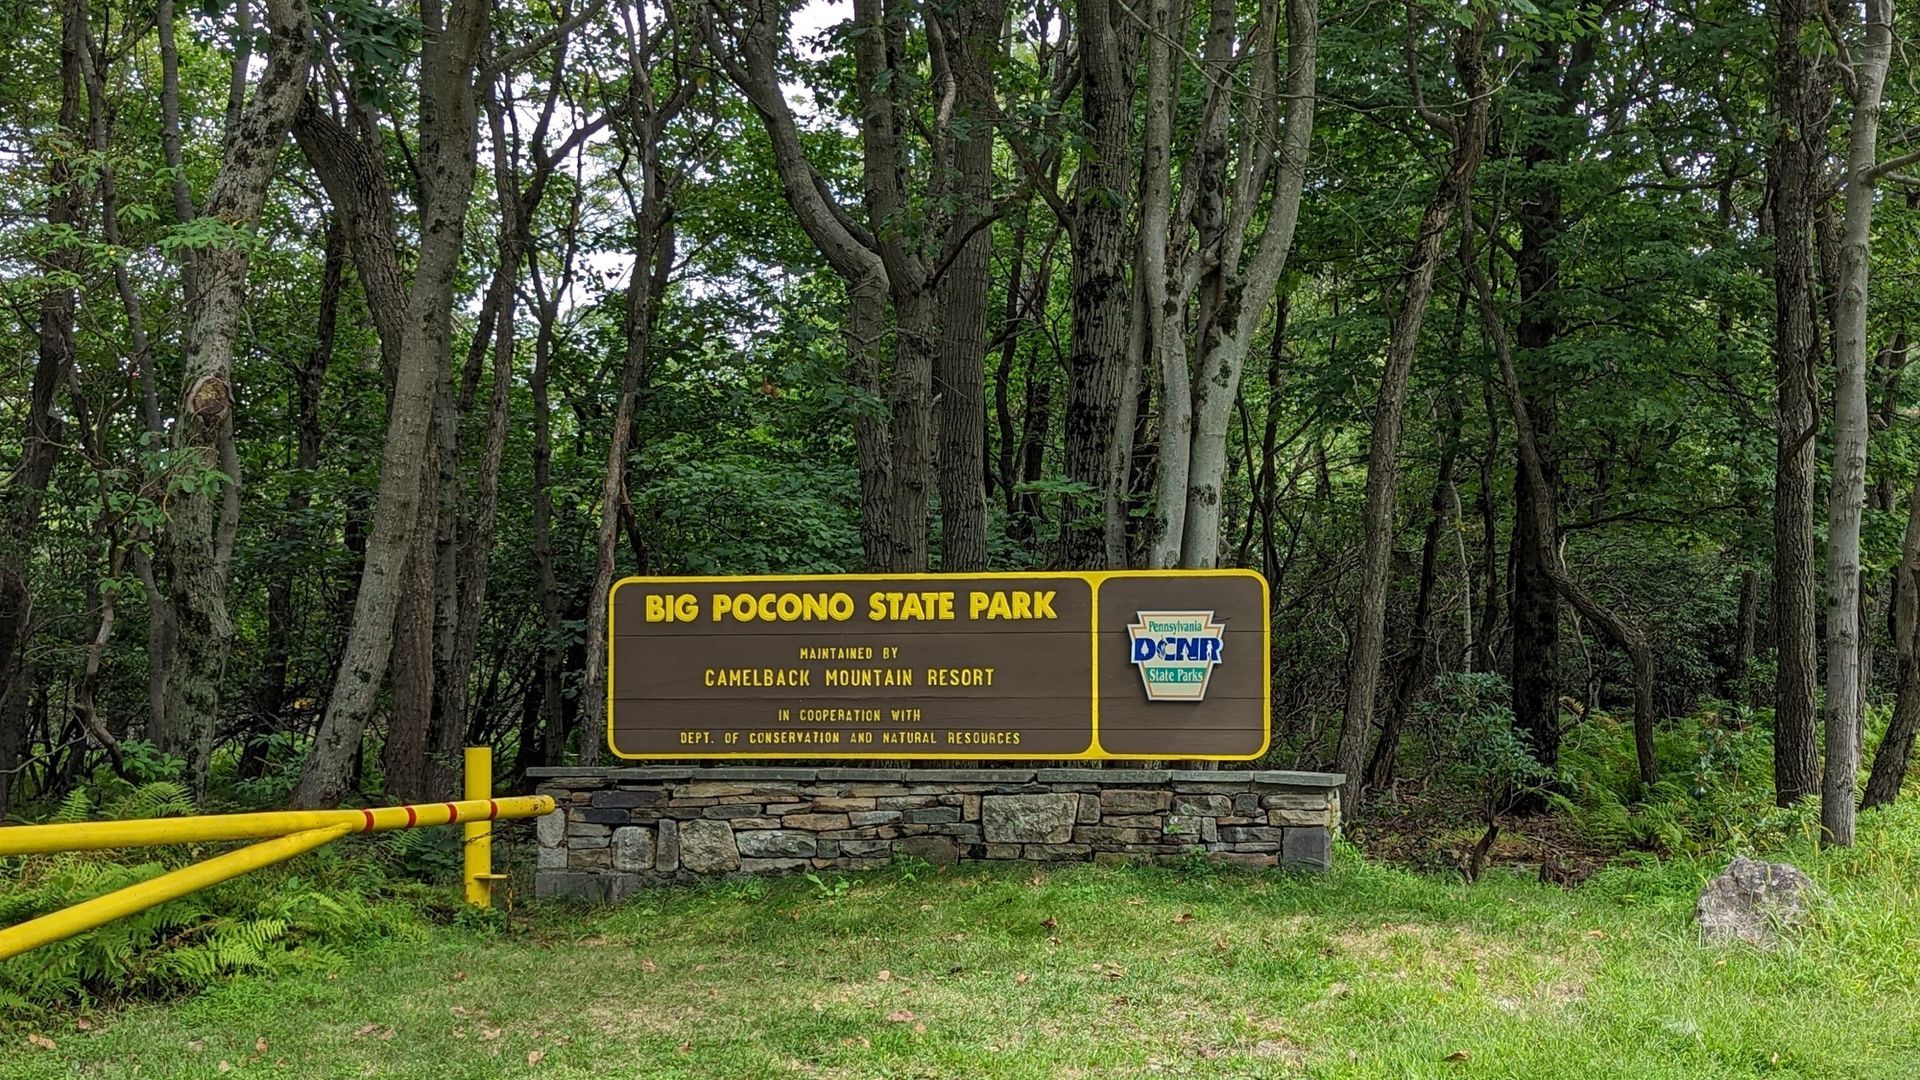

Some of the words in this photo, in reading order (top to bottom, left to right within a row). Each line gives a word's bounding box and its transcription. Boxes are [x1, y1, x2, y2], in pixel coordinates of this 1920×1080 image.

[646, 593, 699, 622] BIG
[713, 592, 855, 622] POCONO
[868, 592, 955, 622] STATE
[970, 591, 1057, 620] PARK
[1149, 620, 1202, 634] Pennsylvania
[799, 647, 873, 660] MAINTAINED
[882, 647, 898, 660] BY
[1134, 636, 1221, 661] DCNR
[704, 669, 810, 687] CAMELBACK
[825, 669, 913, 687] MOUNTAIN
[927, 669, 995, 687] RESORT
[1149, 668, 1175, 682] State
[1177, 668, 1203, 682] Parks
[778, 709, 790, 722] IN
[799, 709, 881, 722] COOPERATION
[890, 709, 921, 721] WITH
[680, 731, 714, 745] DEPT.
[724, 732, 739, 744] OF
[749, 731, 840, 744] CONSERVATION
[850, 731, 873, 744] AND
[882, 731, 937, 744] NATURAL
[947, 731, 1021, 744] RESOURCES
